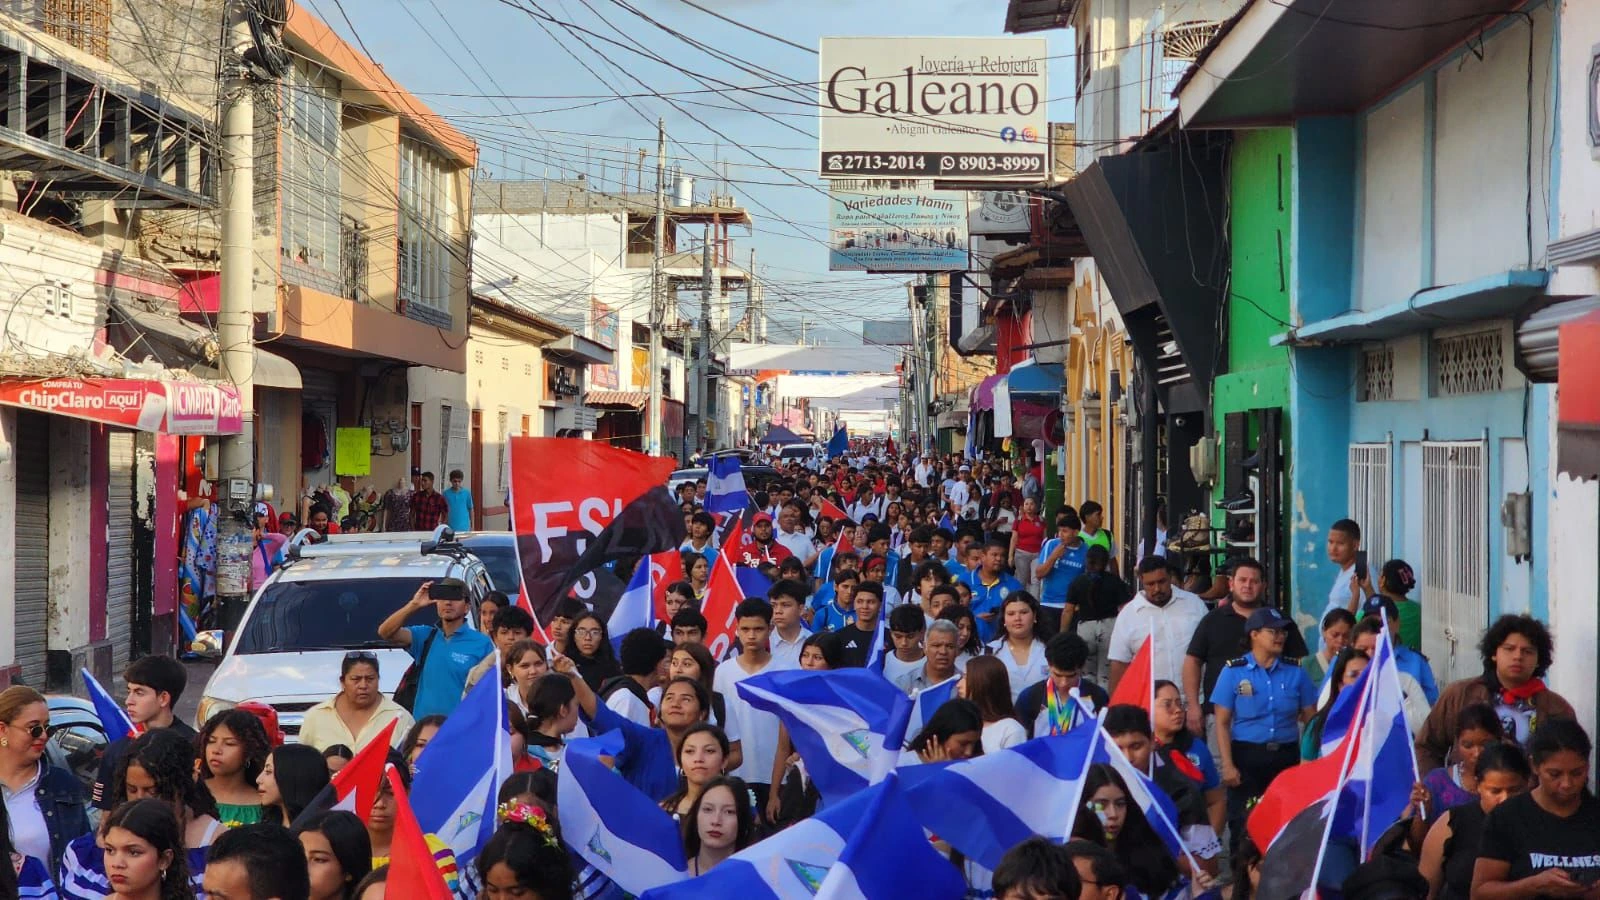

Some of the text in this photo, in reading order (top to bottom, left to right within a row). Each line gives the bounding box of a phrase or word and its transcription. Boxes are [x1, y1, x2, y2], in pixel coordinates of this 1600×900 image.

[919, 55, 964, 76] Joyería
[980, 55, 1038, 76] Relojería
[827, 66, 1039, 116] Galeano
[844, 155, 1040, 171] 2713-2014 8903-8999
[844, 194, 912, 211] Variedades
[19, 389, 138, 410] ChipClaro AQUÍ
